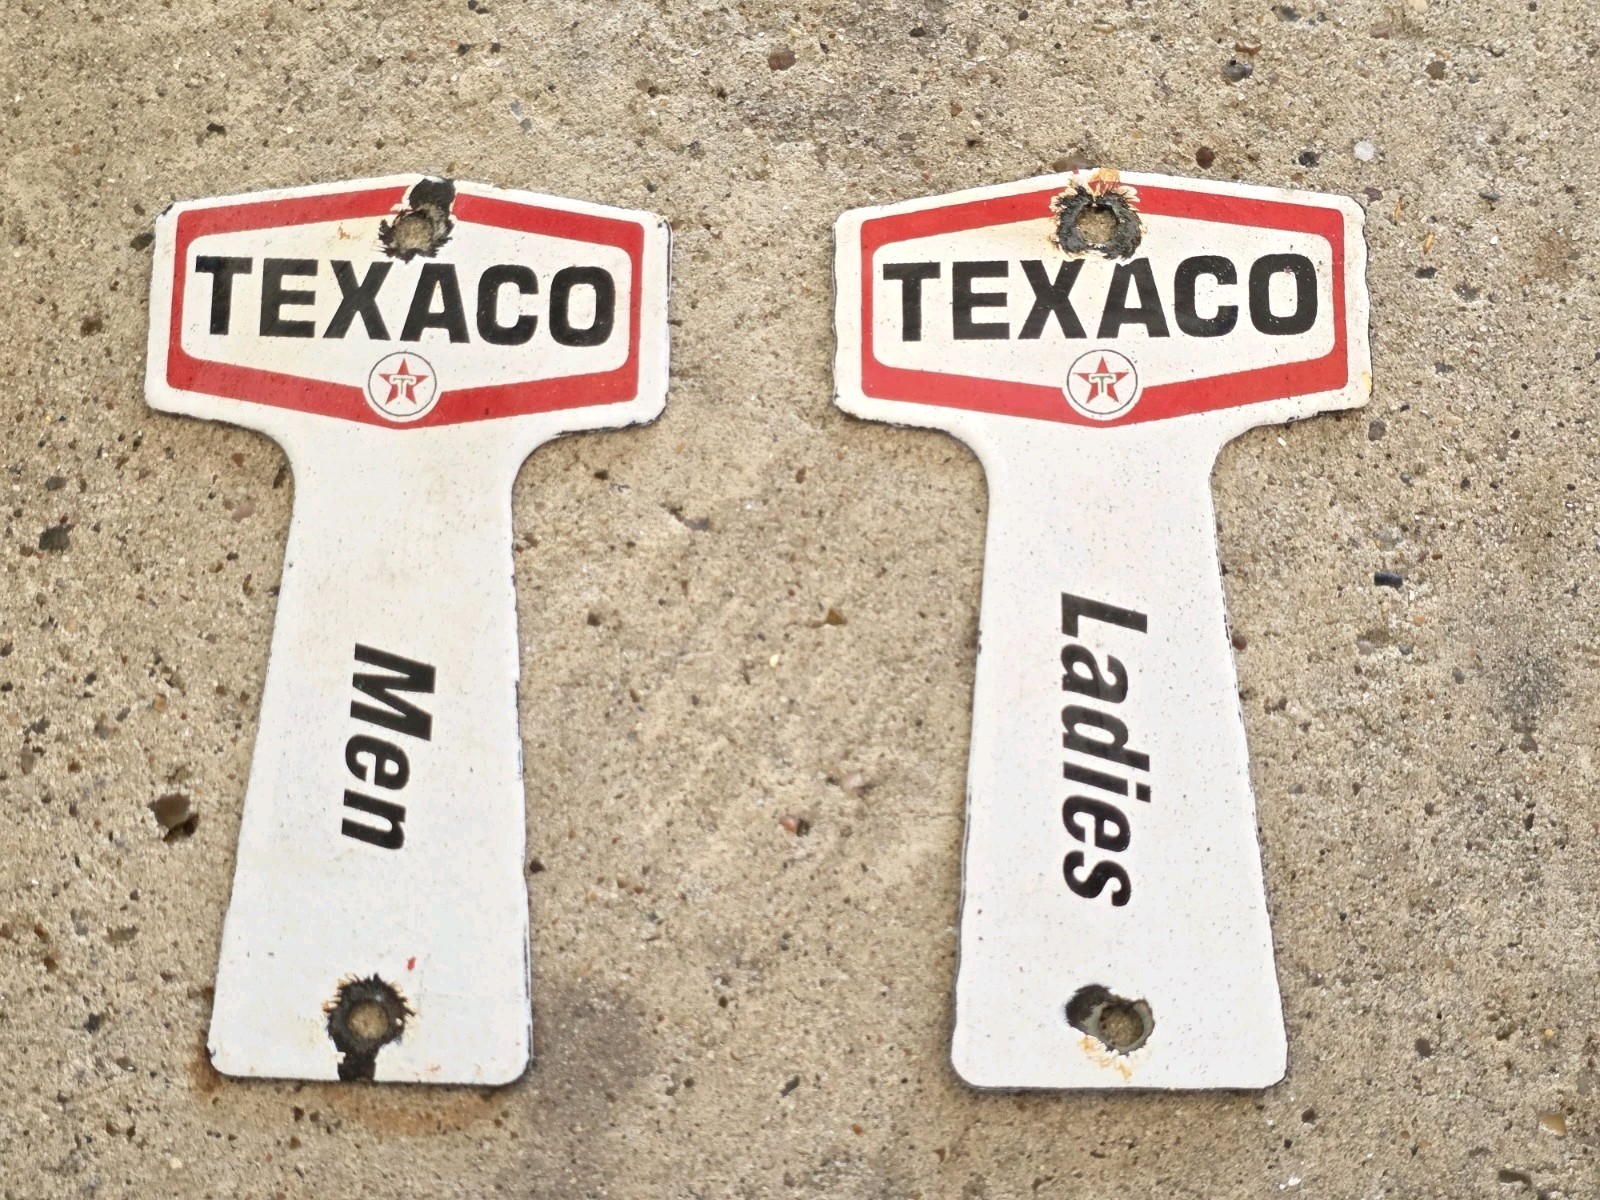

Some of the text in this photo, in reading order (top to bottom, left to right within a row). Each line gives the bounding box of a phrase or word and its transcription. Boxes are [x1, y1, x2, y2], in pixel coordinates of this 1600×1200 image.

[196, 255, 615, 347] TEXACO
[884, 253, 1318, 342] TEXACO
[341, 642, 436, 850] Men
[1062, 592, 1151, 907] Ladies
